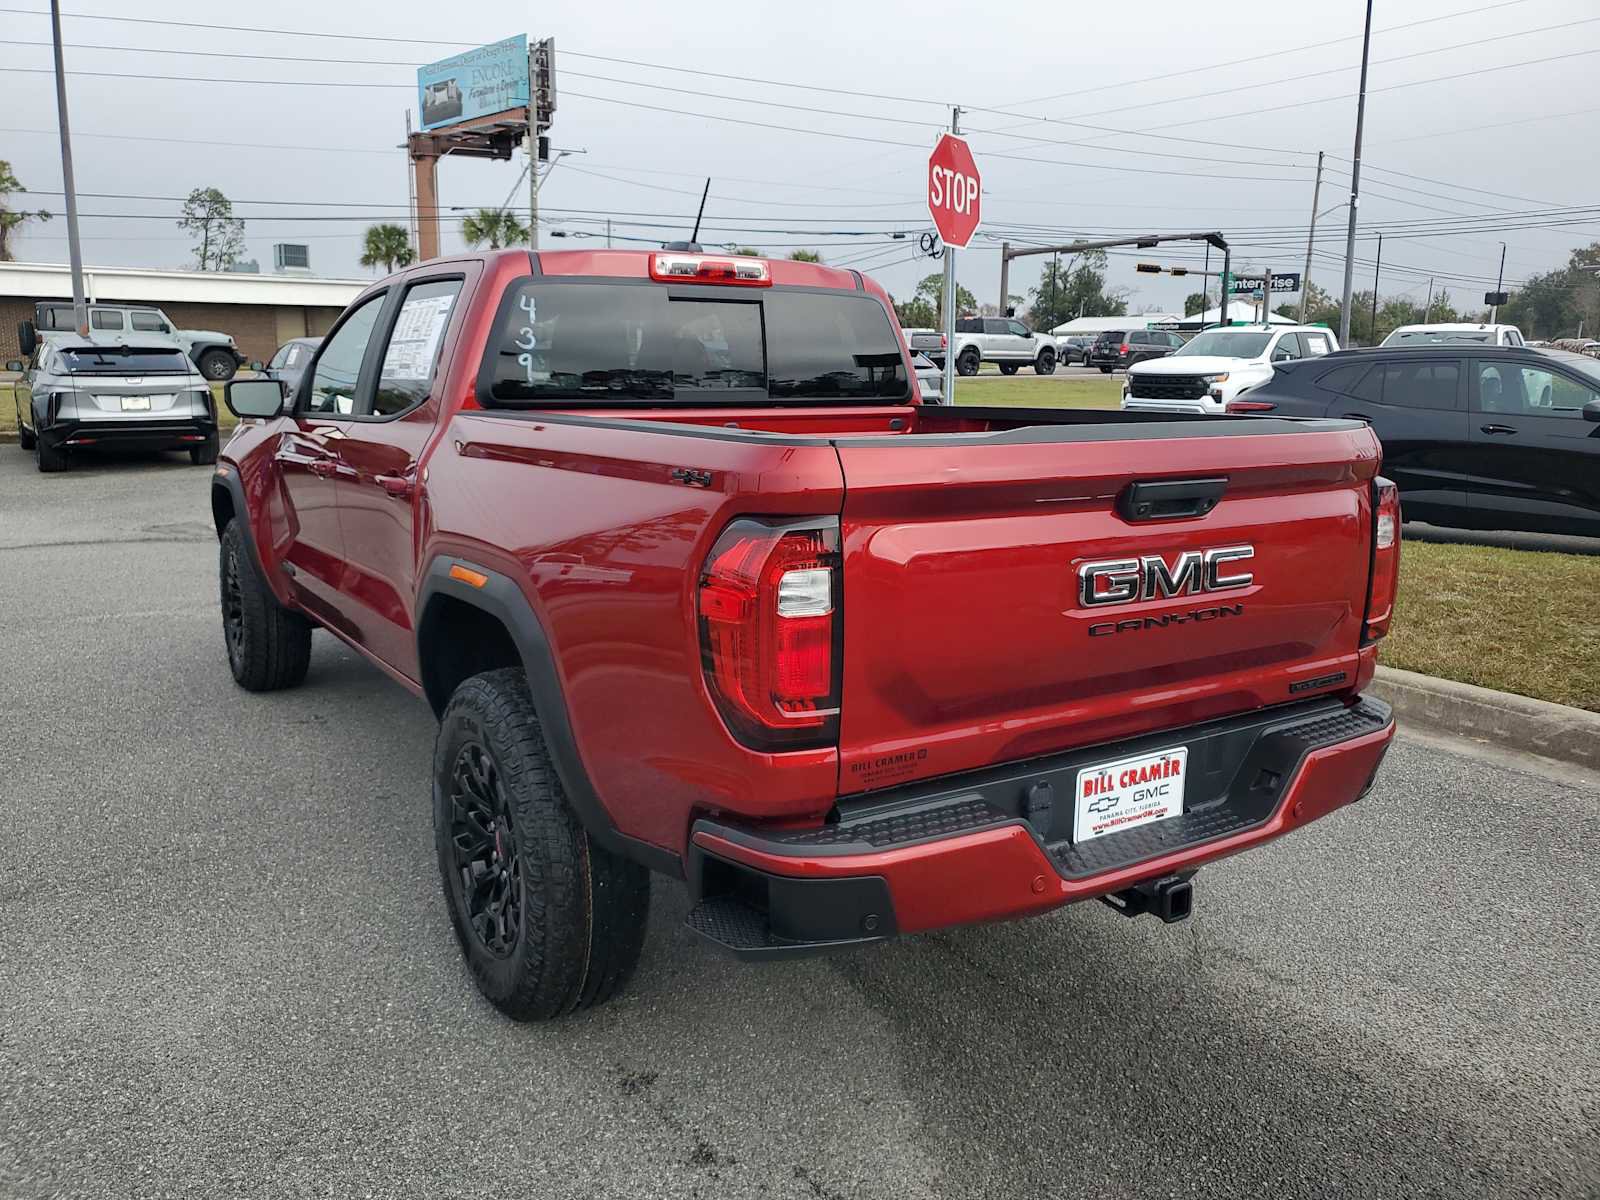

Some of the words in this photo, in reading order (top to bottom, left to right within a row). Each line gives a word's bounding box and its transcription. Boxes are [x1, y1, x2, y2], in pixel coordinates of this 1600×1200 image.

[472, 59, 513, 85] ENCORE
[931, 165, 978, 215] STOP
[1078, 545, 1256, 608] GMC
[1088, 603, 1244, 637] CANYON
[852, 762, 871, 773] BILL
[876, 752, 915, 767] CRAMER
[1083, 774, 1114, 798] BILL
[1120, 759, 1181, 788] CRAMER
[1133, 783, 1170, 802] GMC
[1099, 810, 1123, 821] PANAMA
[1139, 801, 1161, 812] FLORIDA
